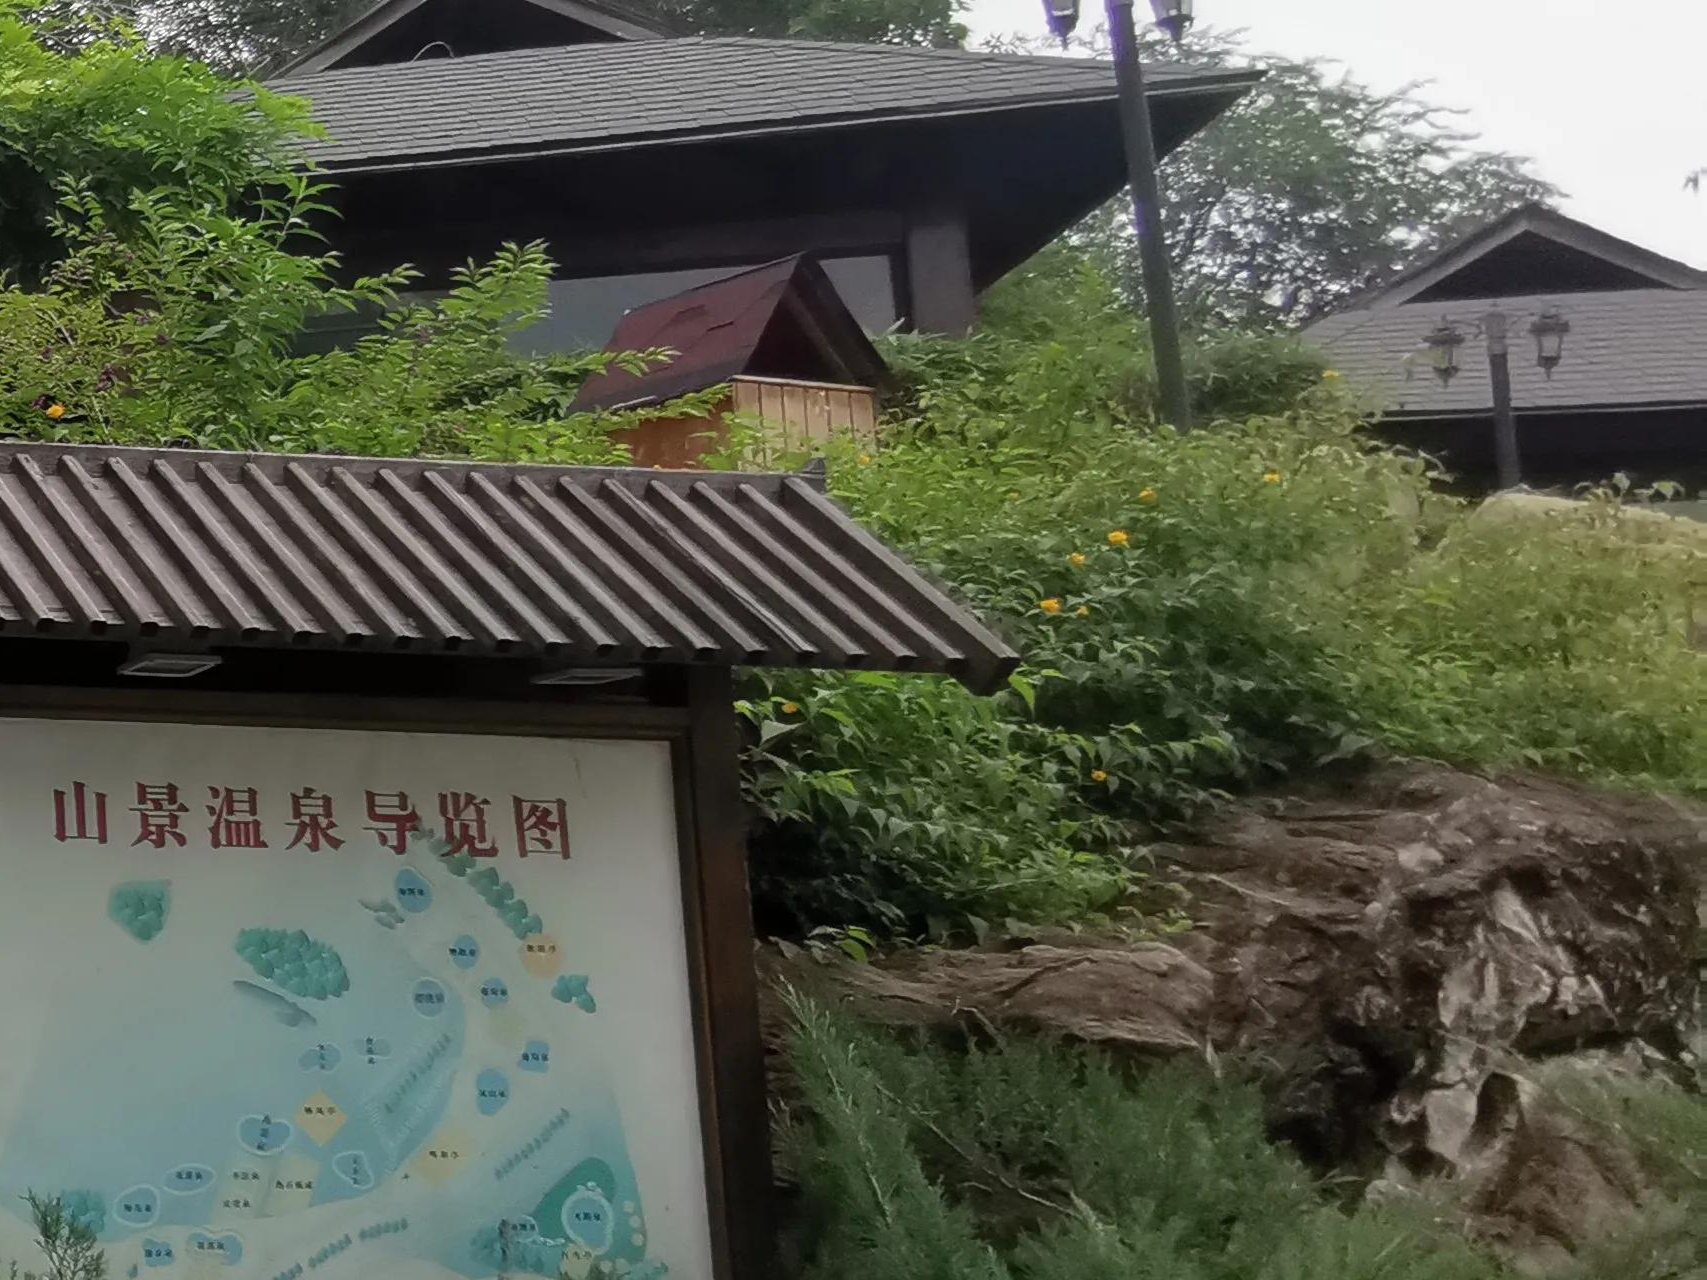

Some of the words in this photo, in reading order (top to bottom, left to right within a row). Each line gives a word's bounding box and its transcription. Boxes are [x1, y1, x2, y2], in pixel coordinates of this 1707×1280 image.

[52, 781, 572, 860] 山景温泉导览图
